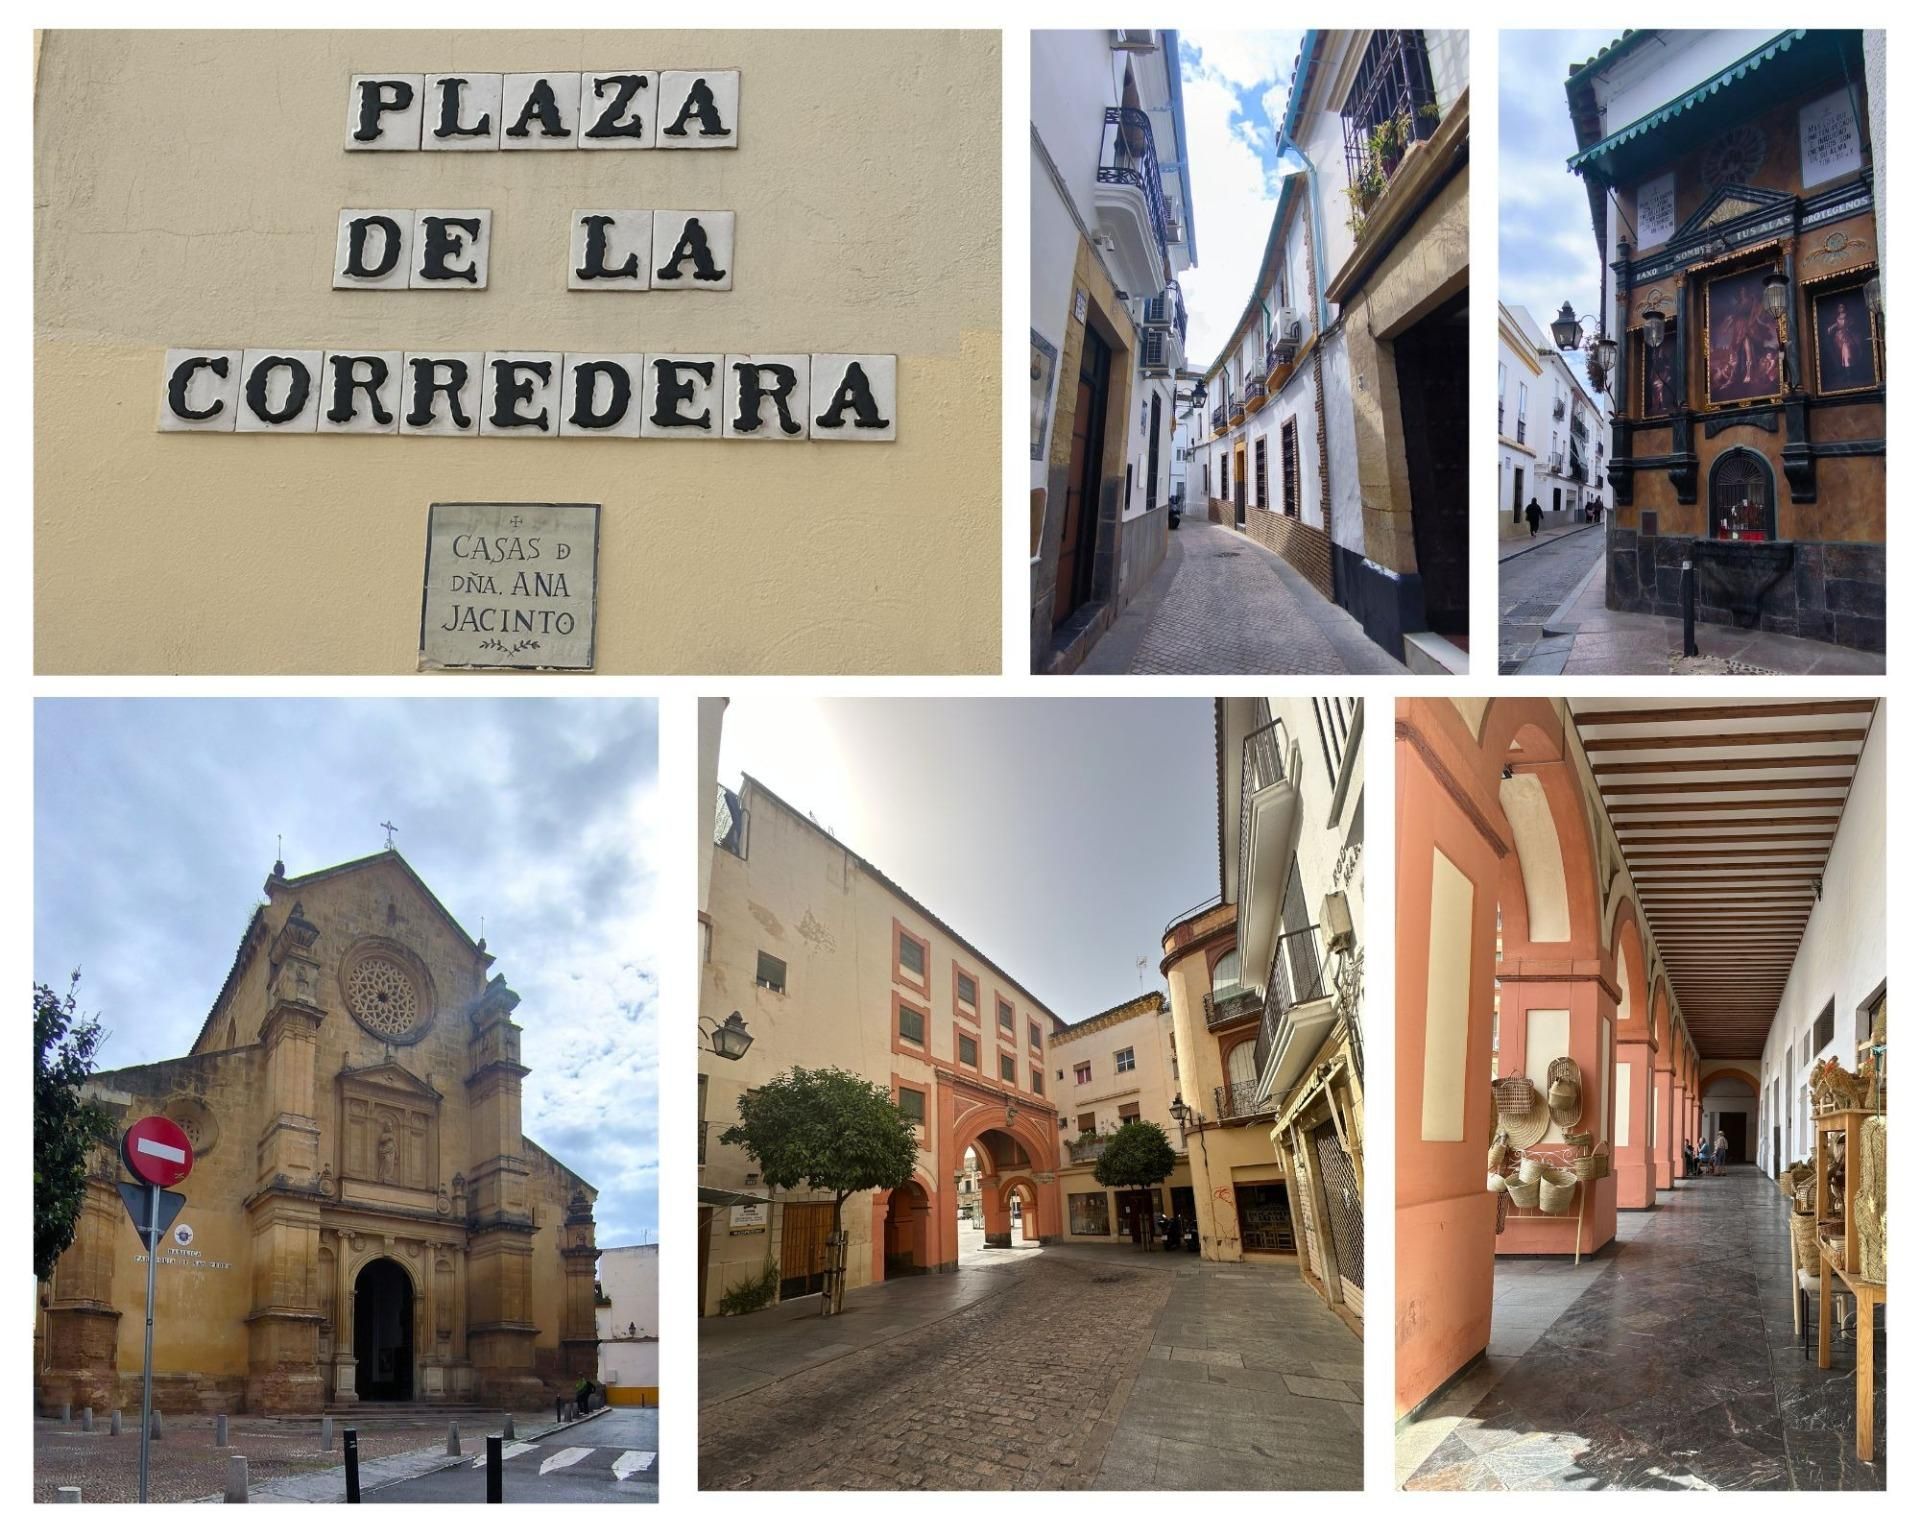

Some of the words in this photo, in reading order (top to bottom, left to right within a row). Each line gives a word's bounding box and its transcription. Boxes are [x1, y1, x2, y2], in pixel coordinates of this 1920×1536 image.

[353, 74, 731, 142] PLAZA
[1736, 227, 1757, 240] TUS
[1760, 214, 1792, 233] ALAS
[1802, 195, 1870, 226] PROTEGENOS
[342, 215, 482, 284] DE
[575, 215, 726, 282] LA
[168, 355, 890, 435] CORREDERA
[452, 534, 541, 563] CASAS
[450, 571, 503, 595] DÑA.
[510, 571, 571, 598] ANA
[441, 604, 575, 635] JACINTO
